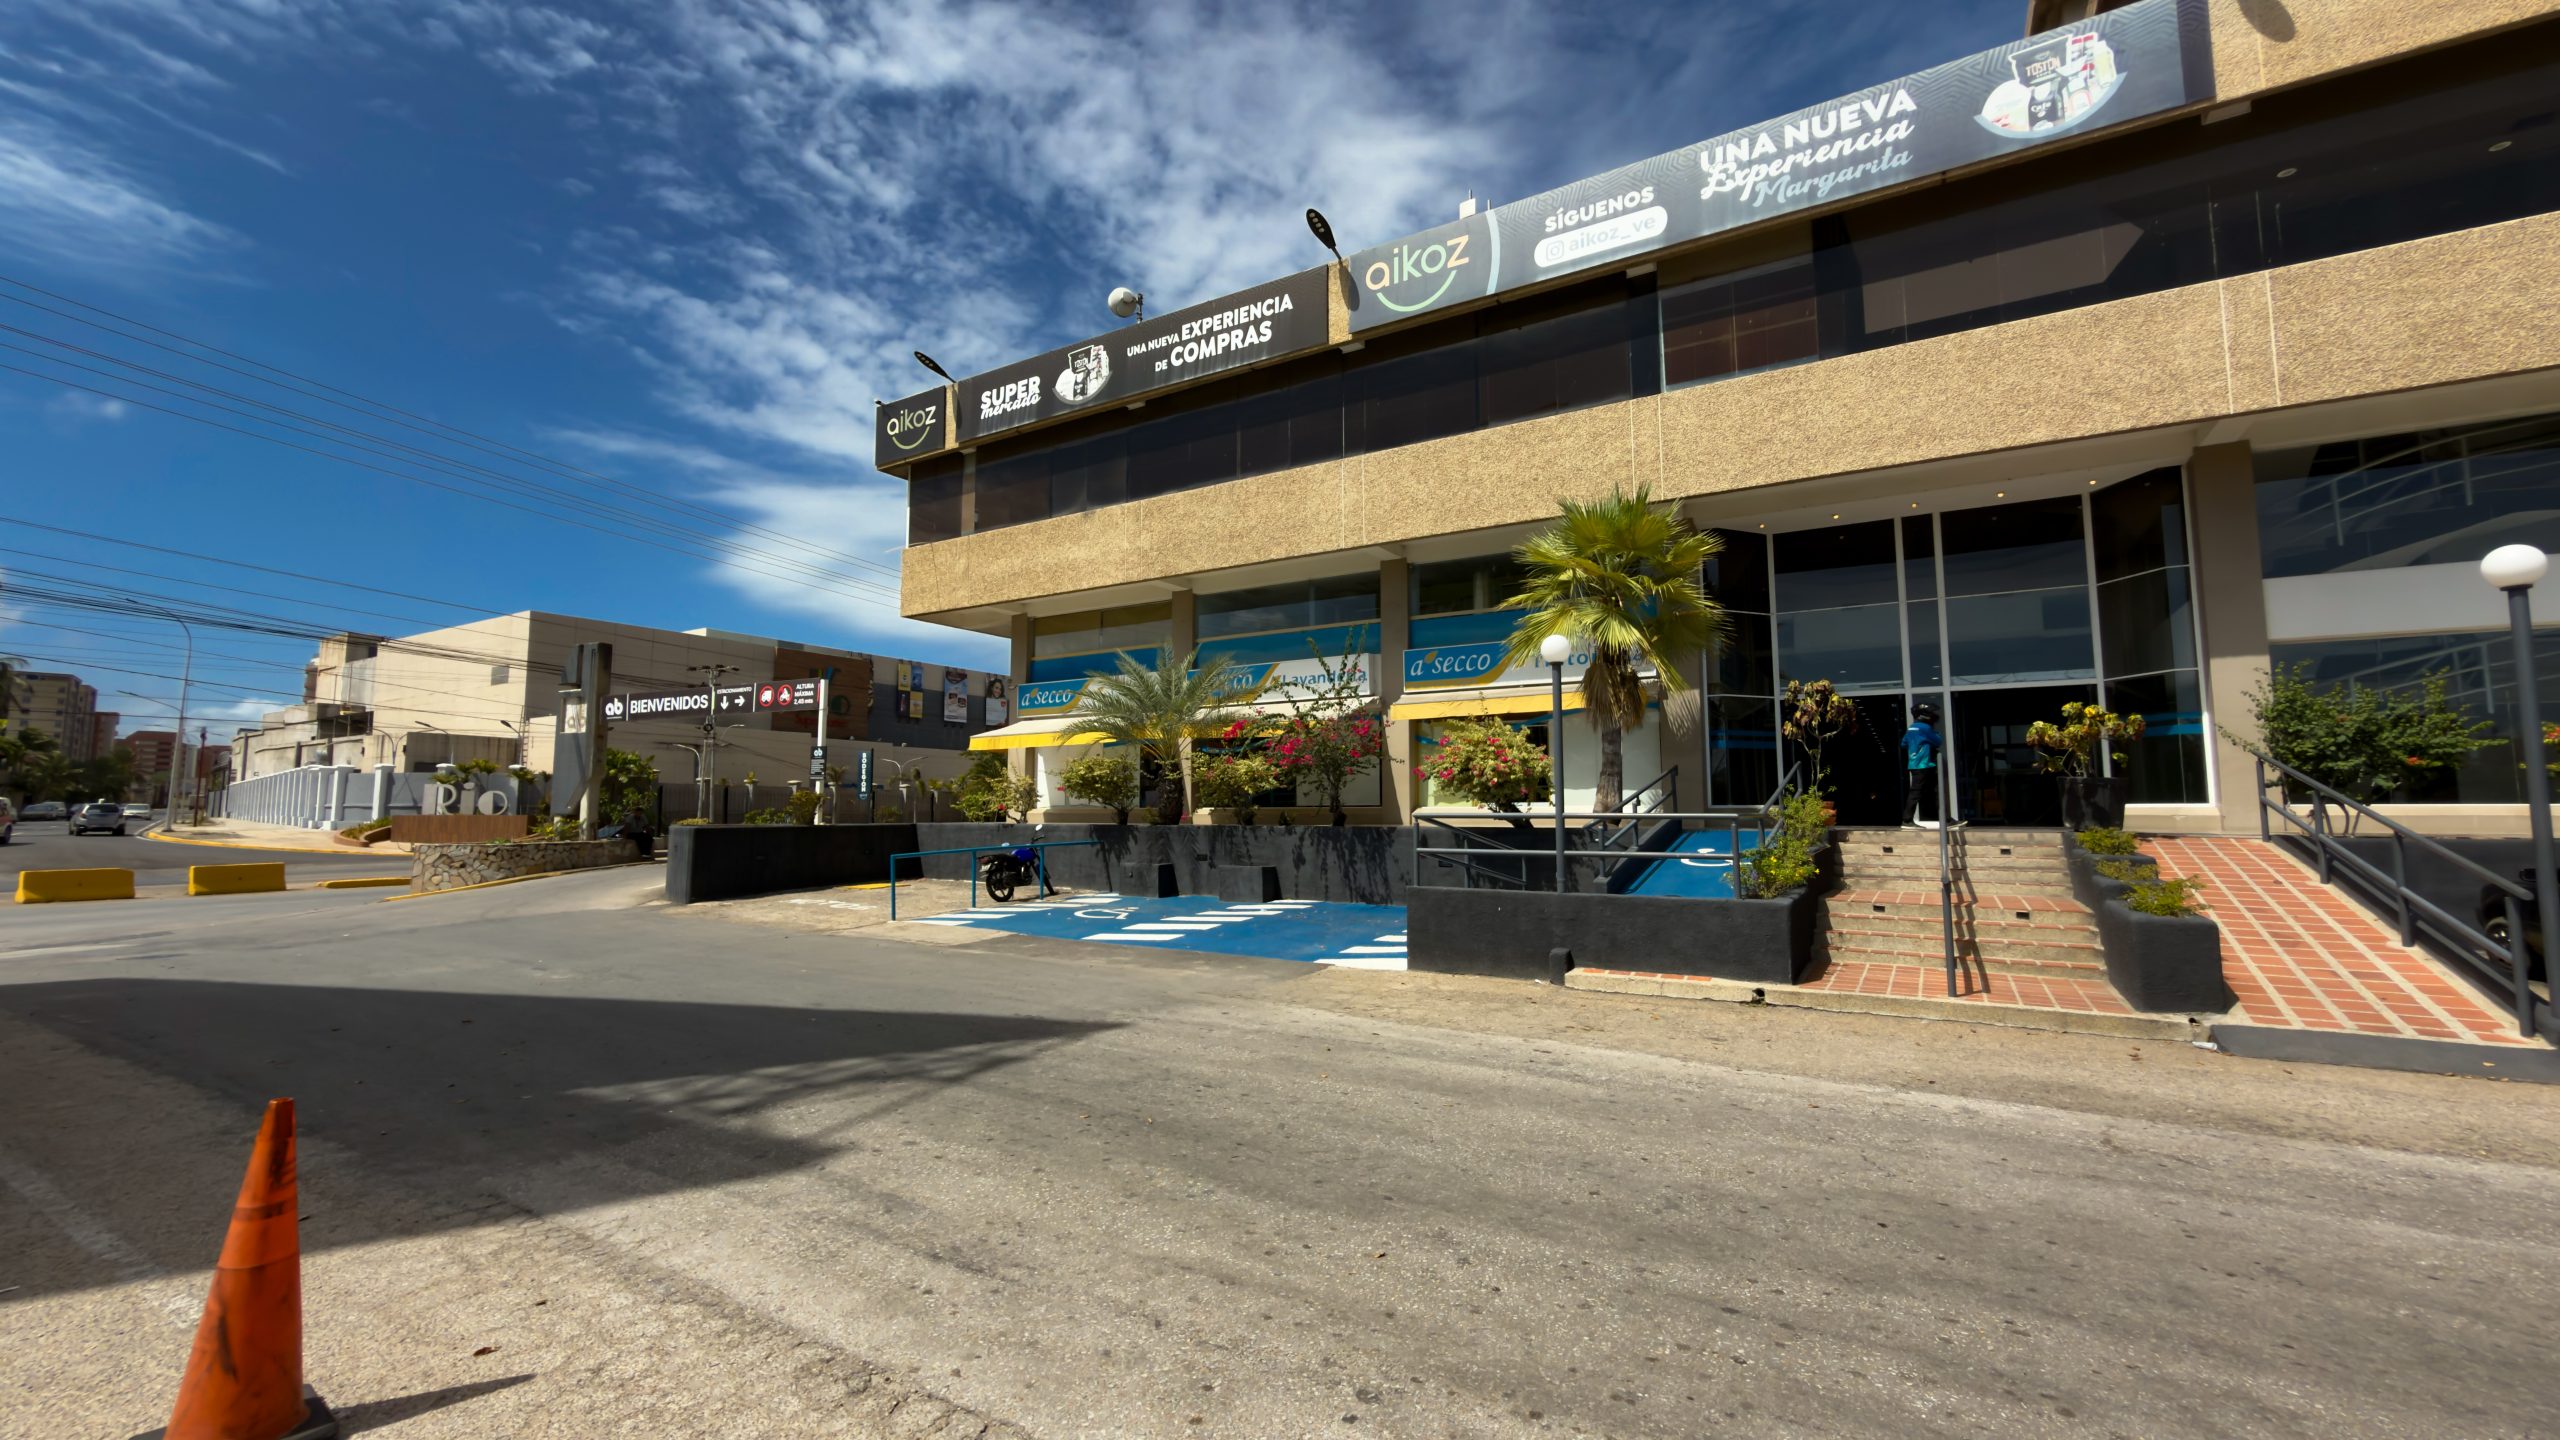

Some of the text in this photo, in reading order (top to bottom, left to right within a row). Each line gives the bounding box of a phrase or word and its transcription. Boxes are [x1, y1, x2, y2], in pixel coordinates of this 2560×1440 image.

[1701, 89, 1917, 171] UNA NUEVA
[1701, 119, 1916, 201] Experiencia
[1753, 146, 1913, 207] Margarita
[1545, 186, 1655, 232] SÍGUENOS
[1365, 234, 1470, 291] aikoz
[1127, 294, 1294, 357] UNA NUEVA EXPERIENCIA
[1155, 321, 1273, 372] DE COMPRAS
[980, 375, 1041, 410] SUPER
[980, 393, 1042, 420] mercado
[886, 405, 937, 435] aikoz
[630, 694, 709, 714] BIENVENIDOS
